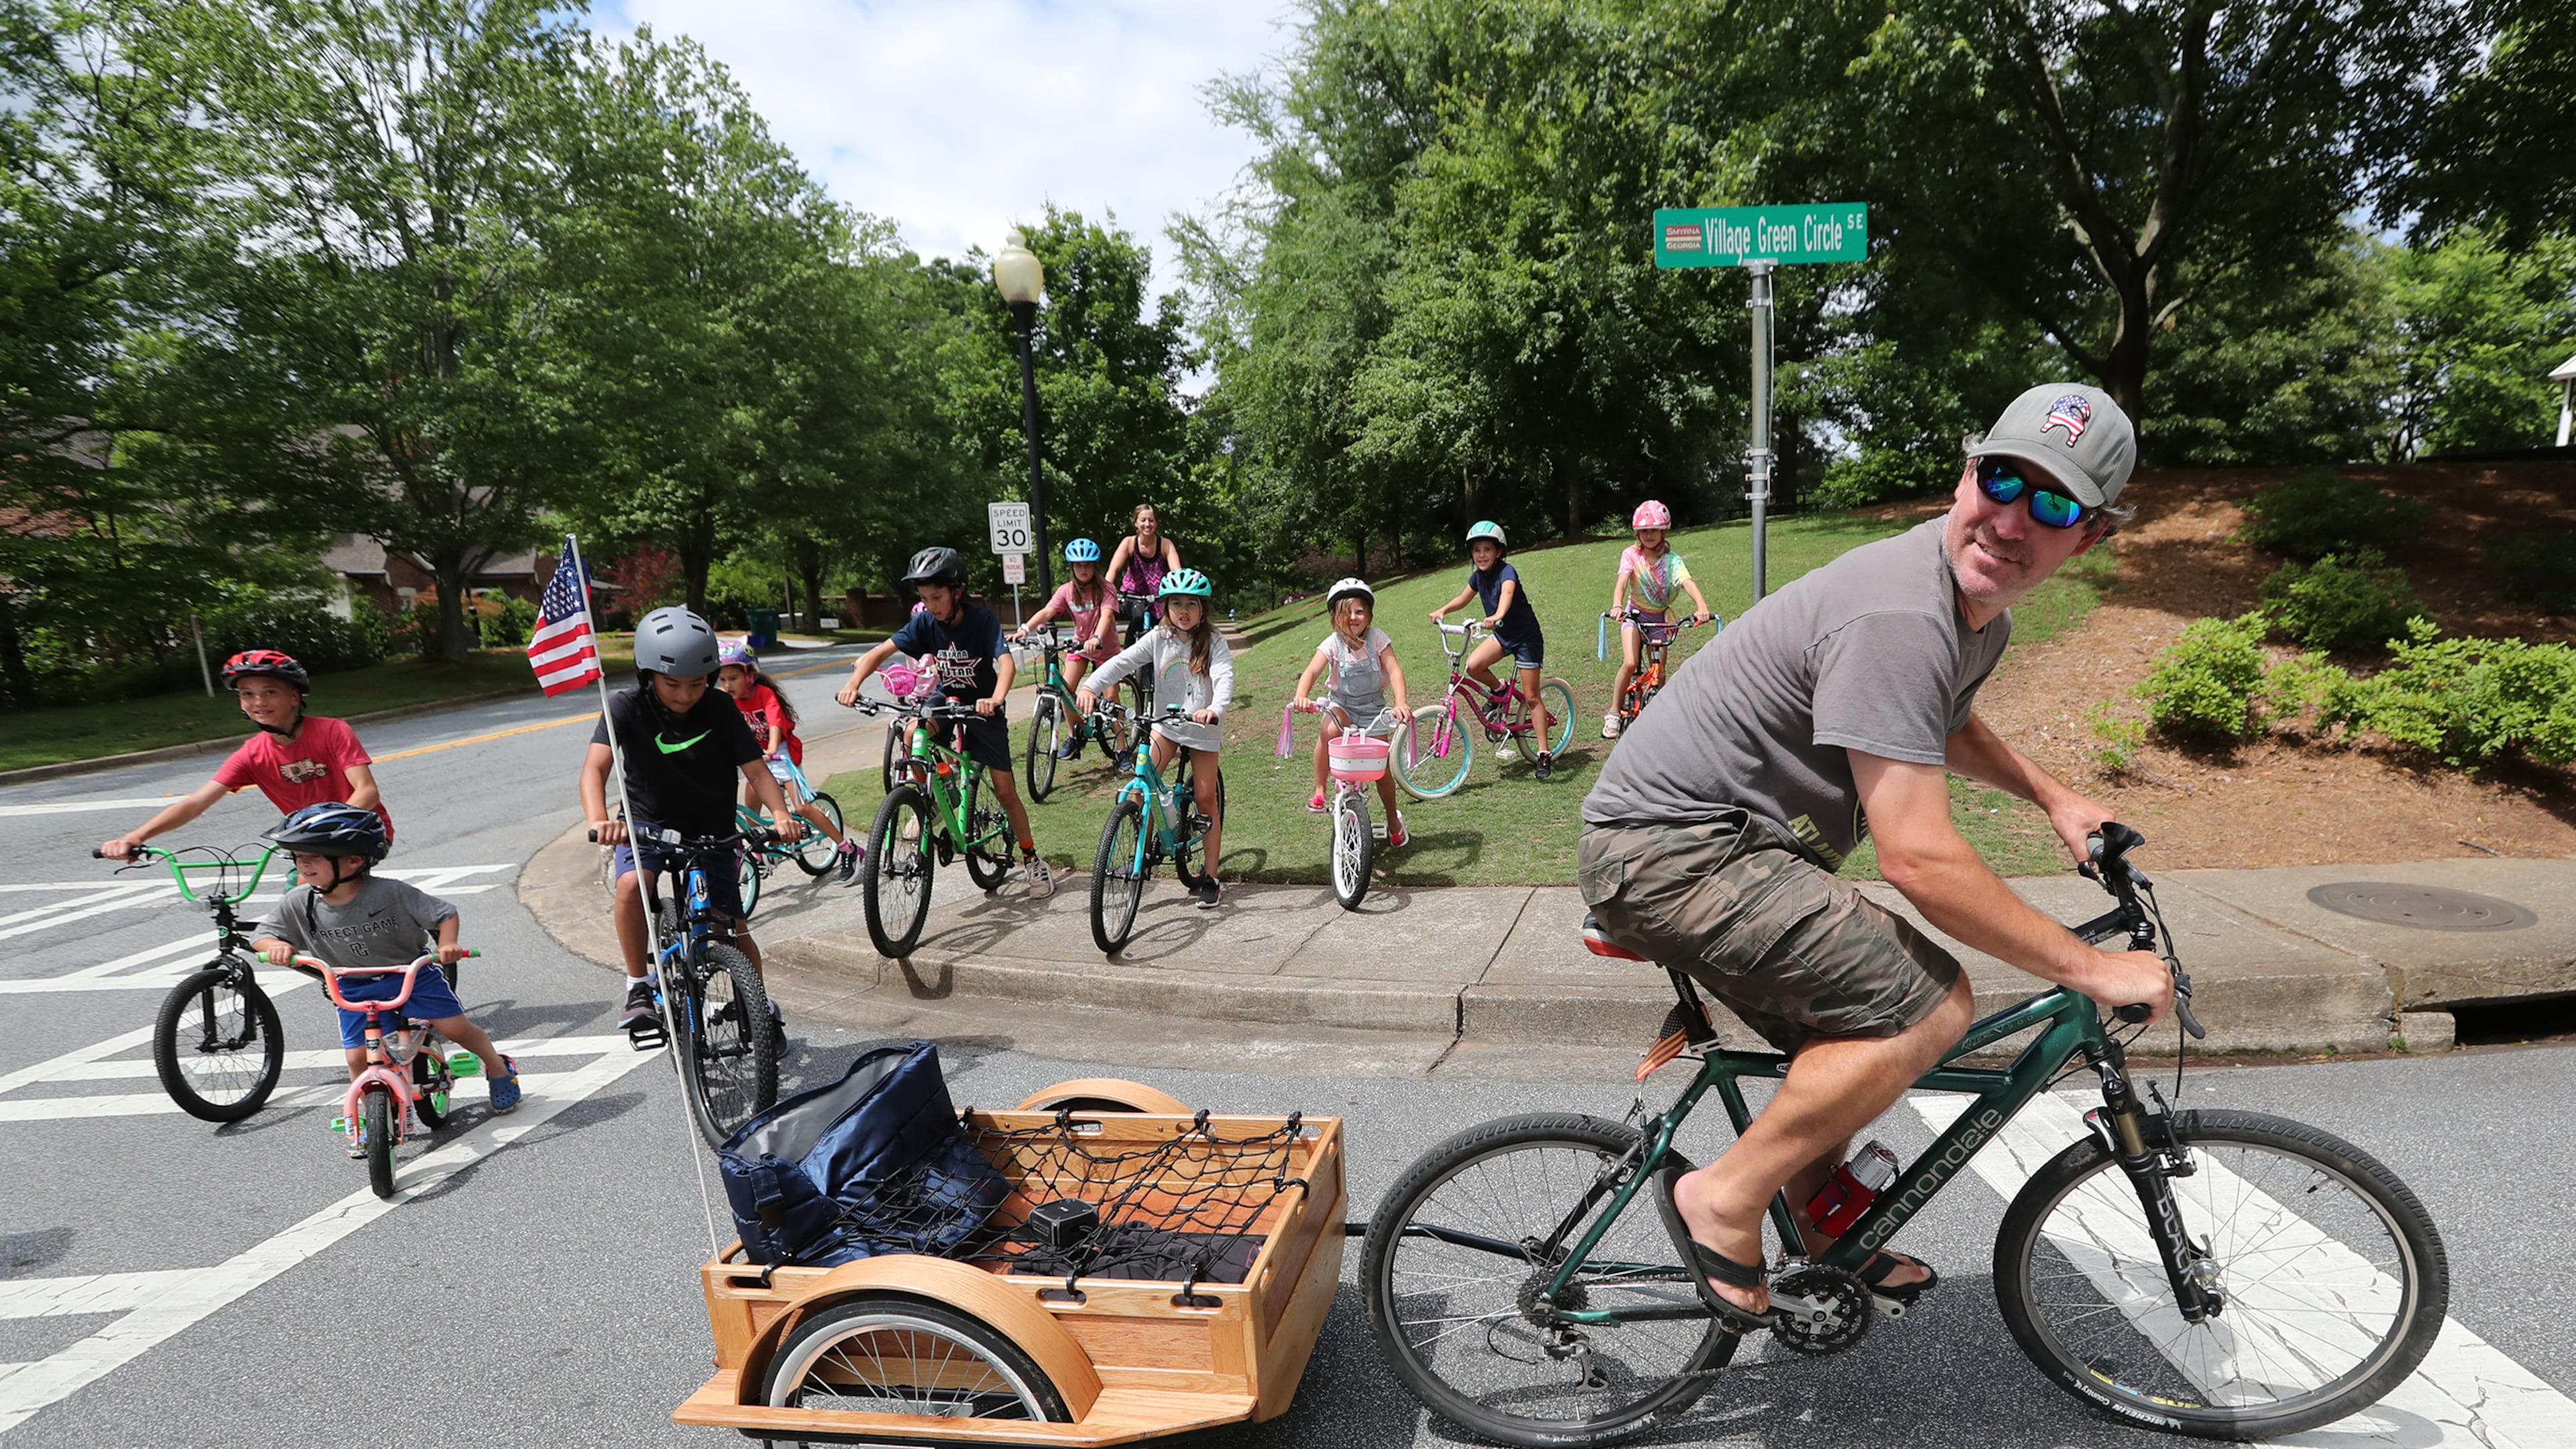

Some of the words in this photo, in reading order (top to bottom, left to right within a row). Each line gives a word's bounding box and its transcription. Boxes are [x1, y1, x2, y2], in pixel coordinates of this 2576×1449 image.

[1666, 227, 1701, 235] SMYRNA
[1705, 217, 1751, 266] Village
[1758, 215, 1796, 254] Green
[1804, 214, 1843, 252] Circle
[1847, 213, 1864, 229] SE
[993, 509, 1025, 517] SPEED
[997, 519, 1022, 527] LIMIT
[997, 529, 1026, 546] 30
[309, 926, 358, 938] PRFECT
[362, 916, 398, 933] GAME
[1859, 1108, 2003, 1251] cannondale
[2081, 1385, 2111, 1406] Country
[2112, 1403, 2167, 1426] MICHELIN
[1560, 1433, 1592, 1444] Country
